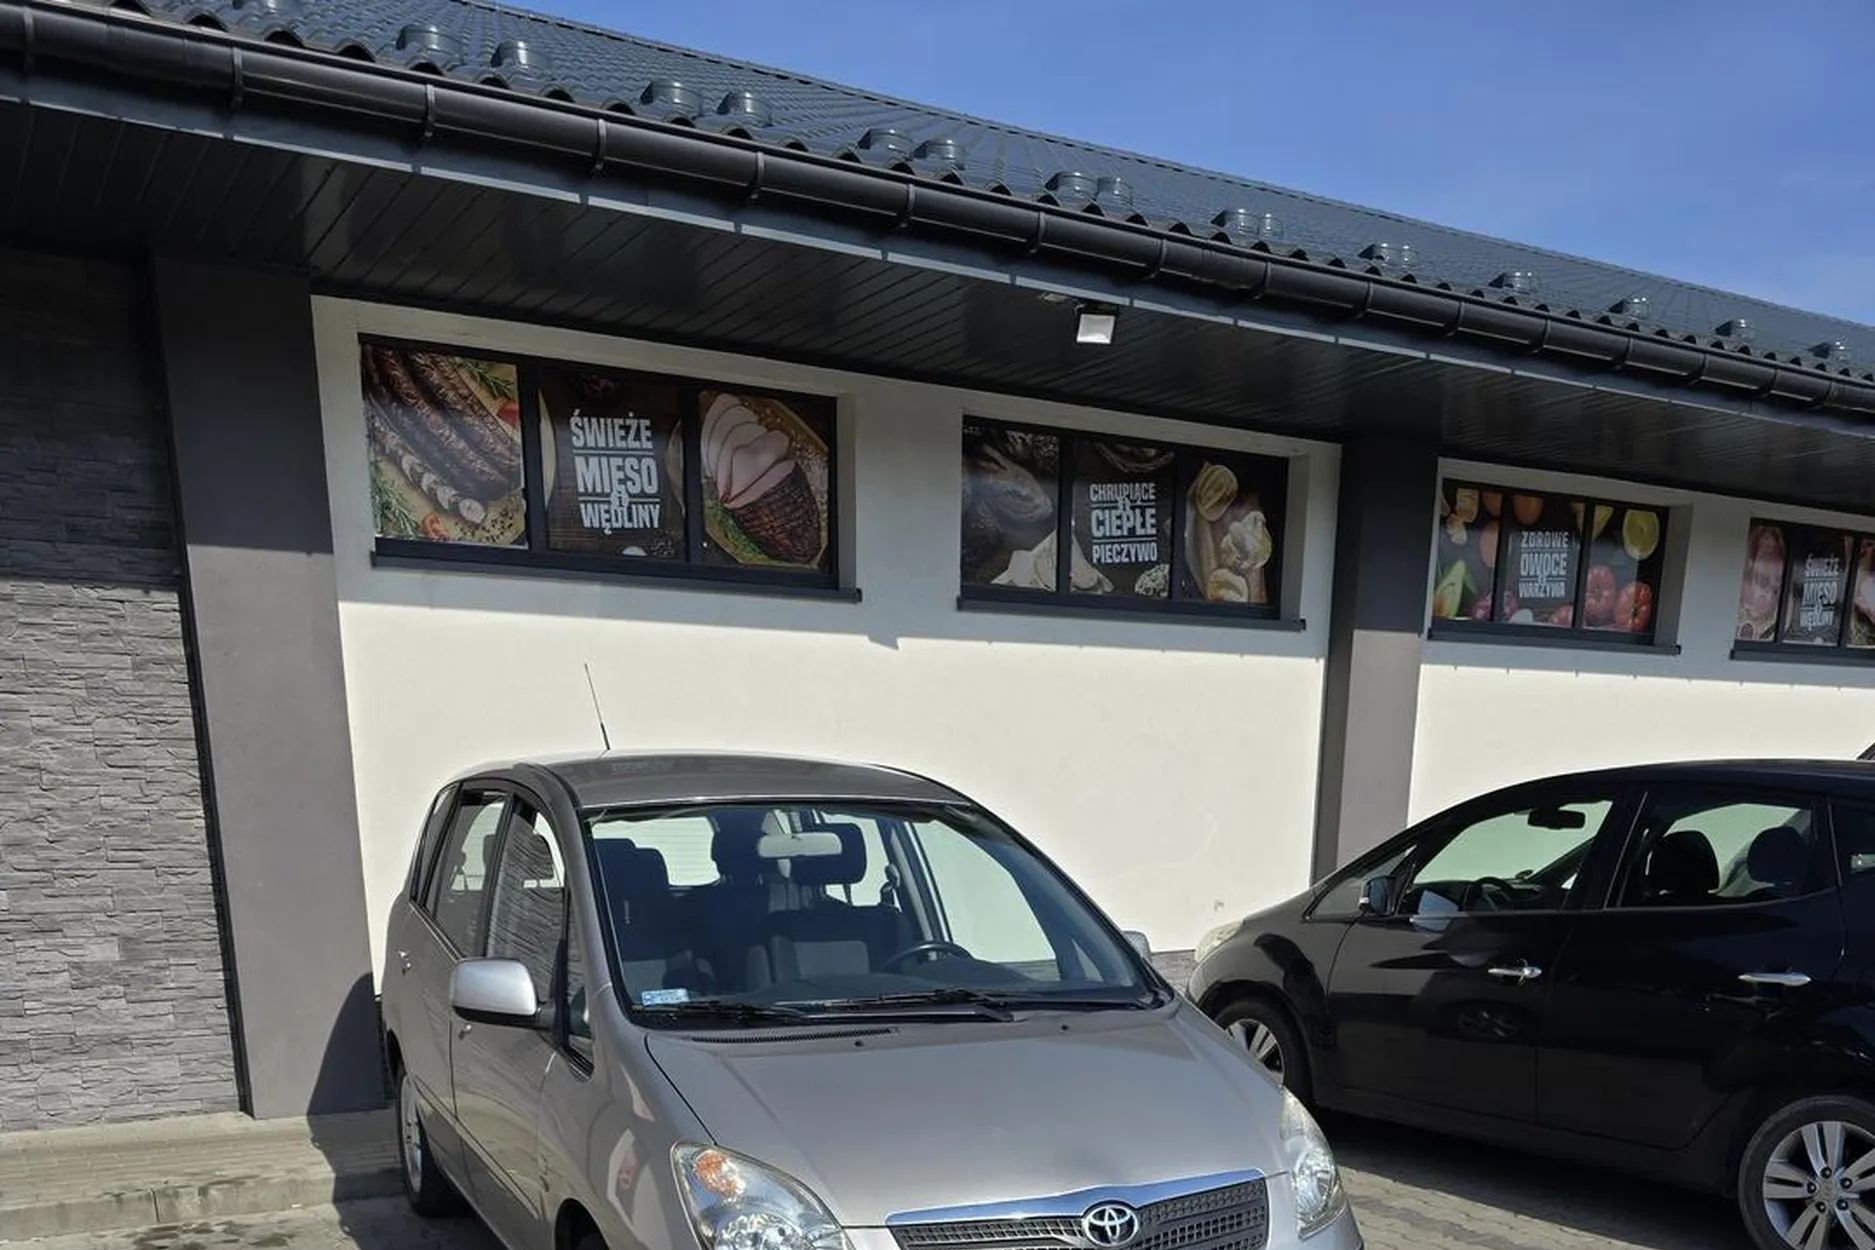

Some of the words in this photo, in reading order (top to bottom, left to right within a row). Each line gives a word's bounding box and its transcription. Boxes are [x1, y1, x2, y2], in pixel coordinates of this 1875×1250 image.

[569, 408, 654, 449] ŚWIEŻE
[574, 456, 659, 494] MIĘSO
[1089, 483, 1157, 504] CHRUPIĄCE
[580, 503, 660, 535] WĘDLINY
[1091, 508, 1157, 537] CIEPŁE
[1092, 542, 1158, 564] PIECZYWO
[1520, 553, 1568, 577] OWOCE
